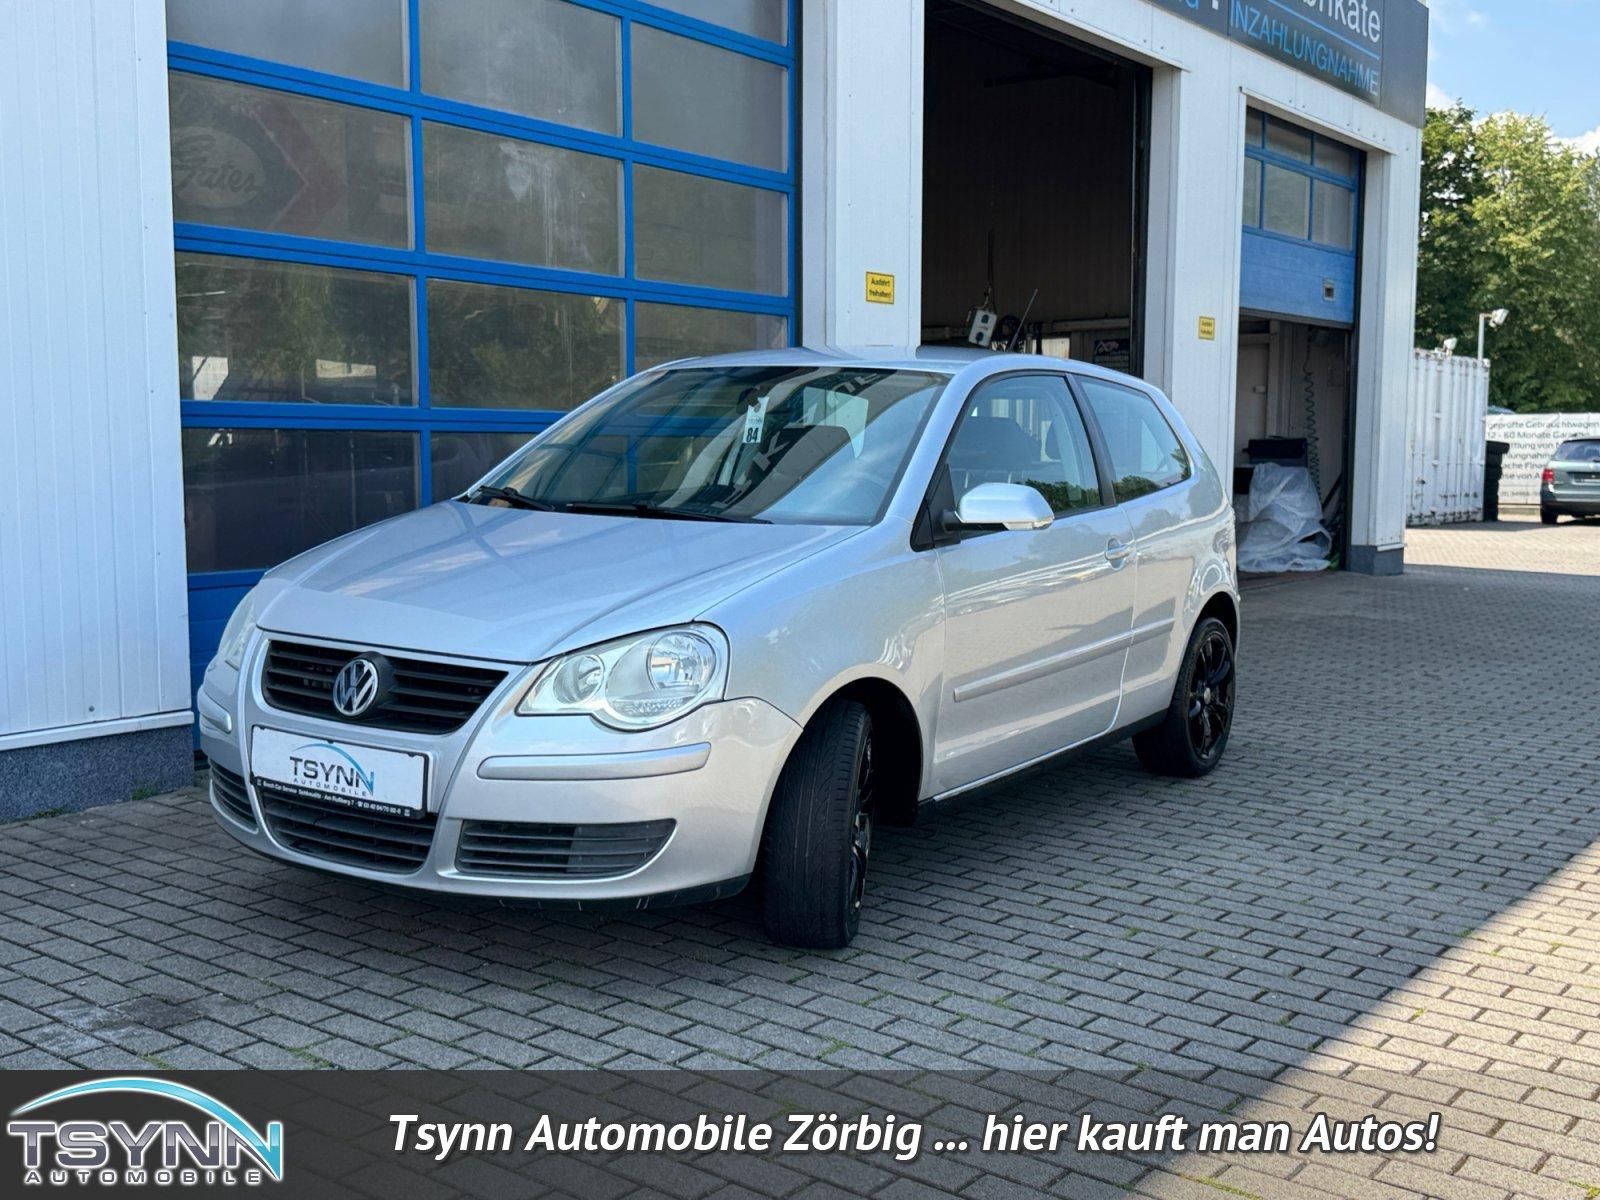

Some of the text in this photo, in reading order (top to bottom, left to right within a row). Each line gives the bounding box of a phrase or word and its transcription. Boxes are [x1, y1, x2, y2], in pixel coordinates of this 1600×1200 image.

[1230, 0, 1379, 97] INZAHLUNGNAHME
[746, 427, 759, 443] 84
[1517, 431, 1551, 440] Monate
[290, 756, 375, 796] TSYNN
[293, 778, 368, 798] AUTOMOBILE
